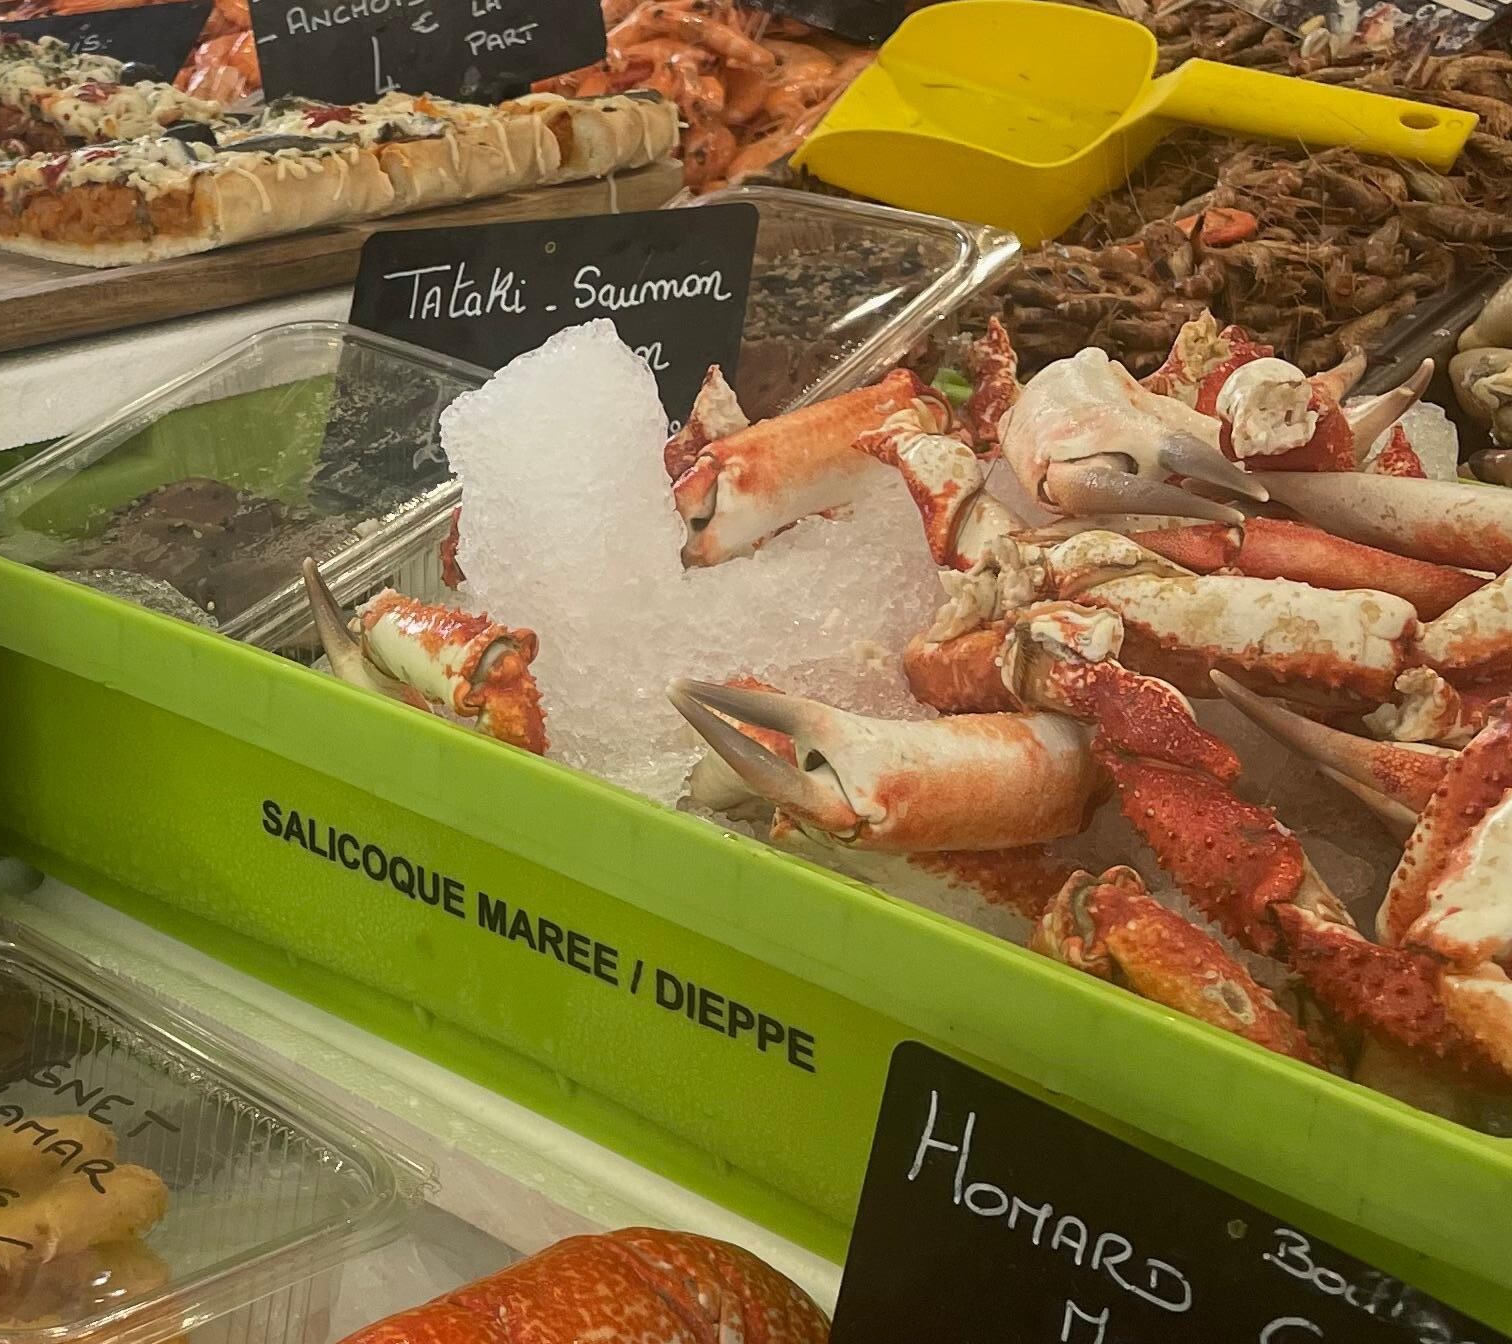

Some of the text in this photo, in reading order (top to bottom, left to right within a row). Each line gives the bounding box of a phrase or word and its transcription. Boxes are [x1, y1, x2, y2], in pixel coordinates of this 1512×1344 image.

[410, 10, 441, 35] €
[464, 21, 540, 57] PART
[572, 264, 733, 312] Saumon
[260, 798, 818, 1074] SALICOQUE MAREE / DIEPPE
[906, 1089, 1193, 1312] HOMARD
